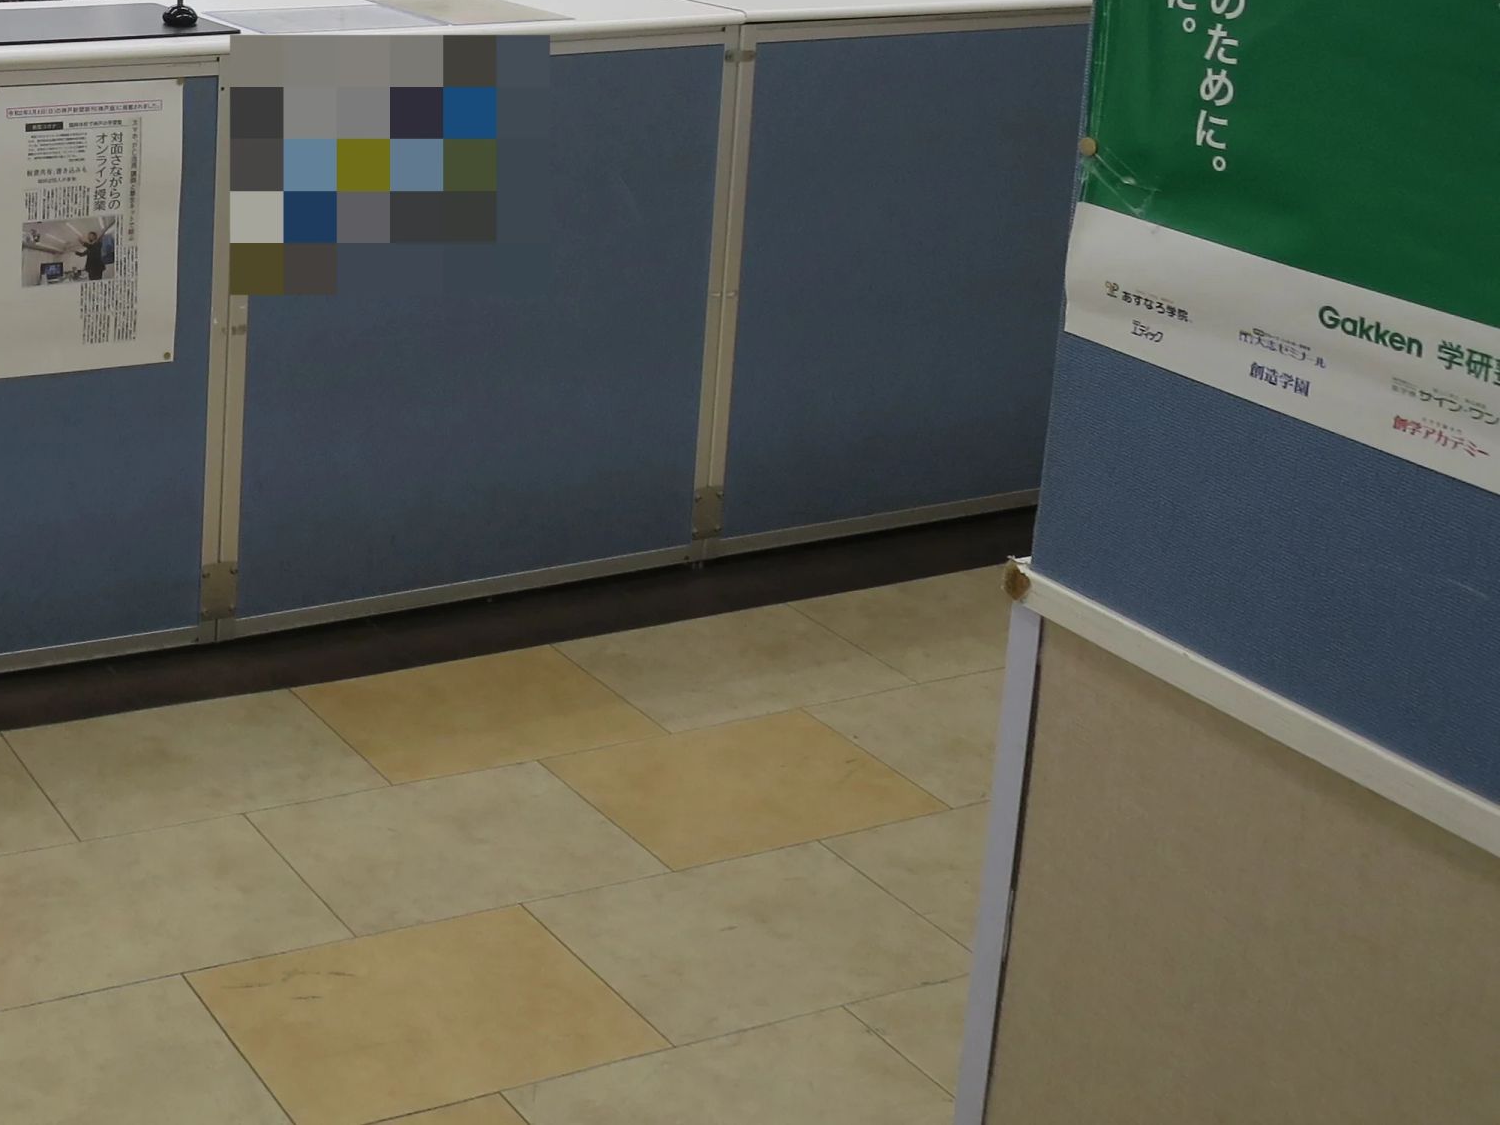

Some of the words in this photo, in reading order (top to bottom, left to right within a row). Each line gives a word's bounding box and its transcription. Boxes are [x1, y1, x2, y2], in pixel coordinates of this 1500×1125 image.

[93, 133, 108, 211] オンライン授業
[108, 132, 123, 210] 対面さながらの
[1122, 291, 1188, 322] あすなろ学院
[1318, 305, 1423, 358] Gakken
[1250, 362, 1311, 397] 創造学園
[1392, 415, 1490, 458] 創学アカデミー
